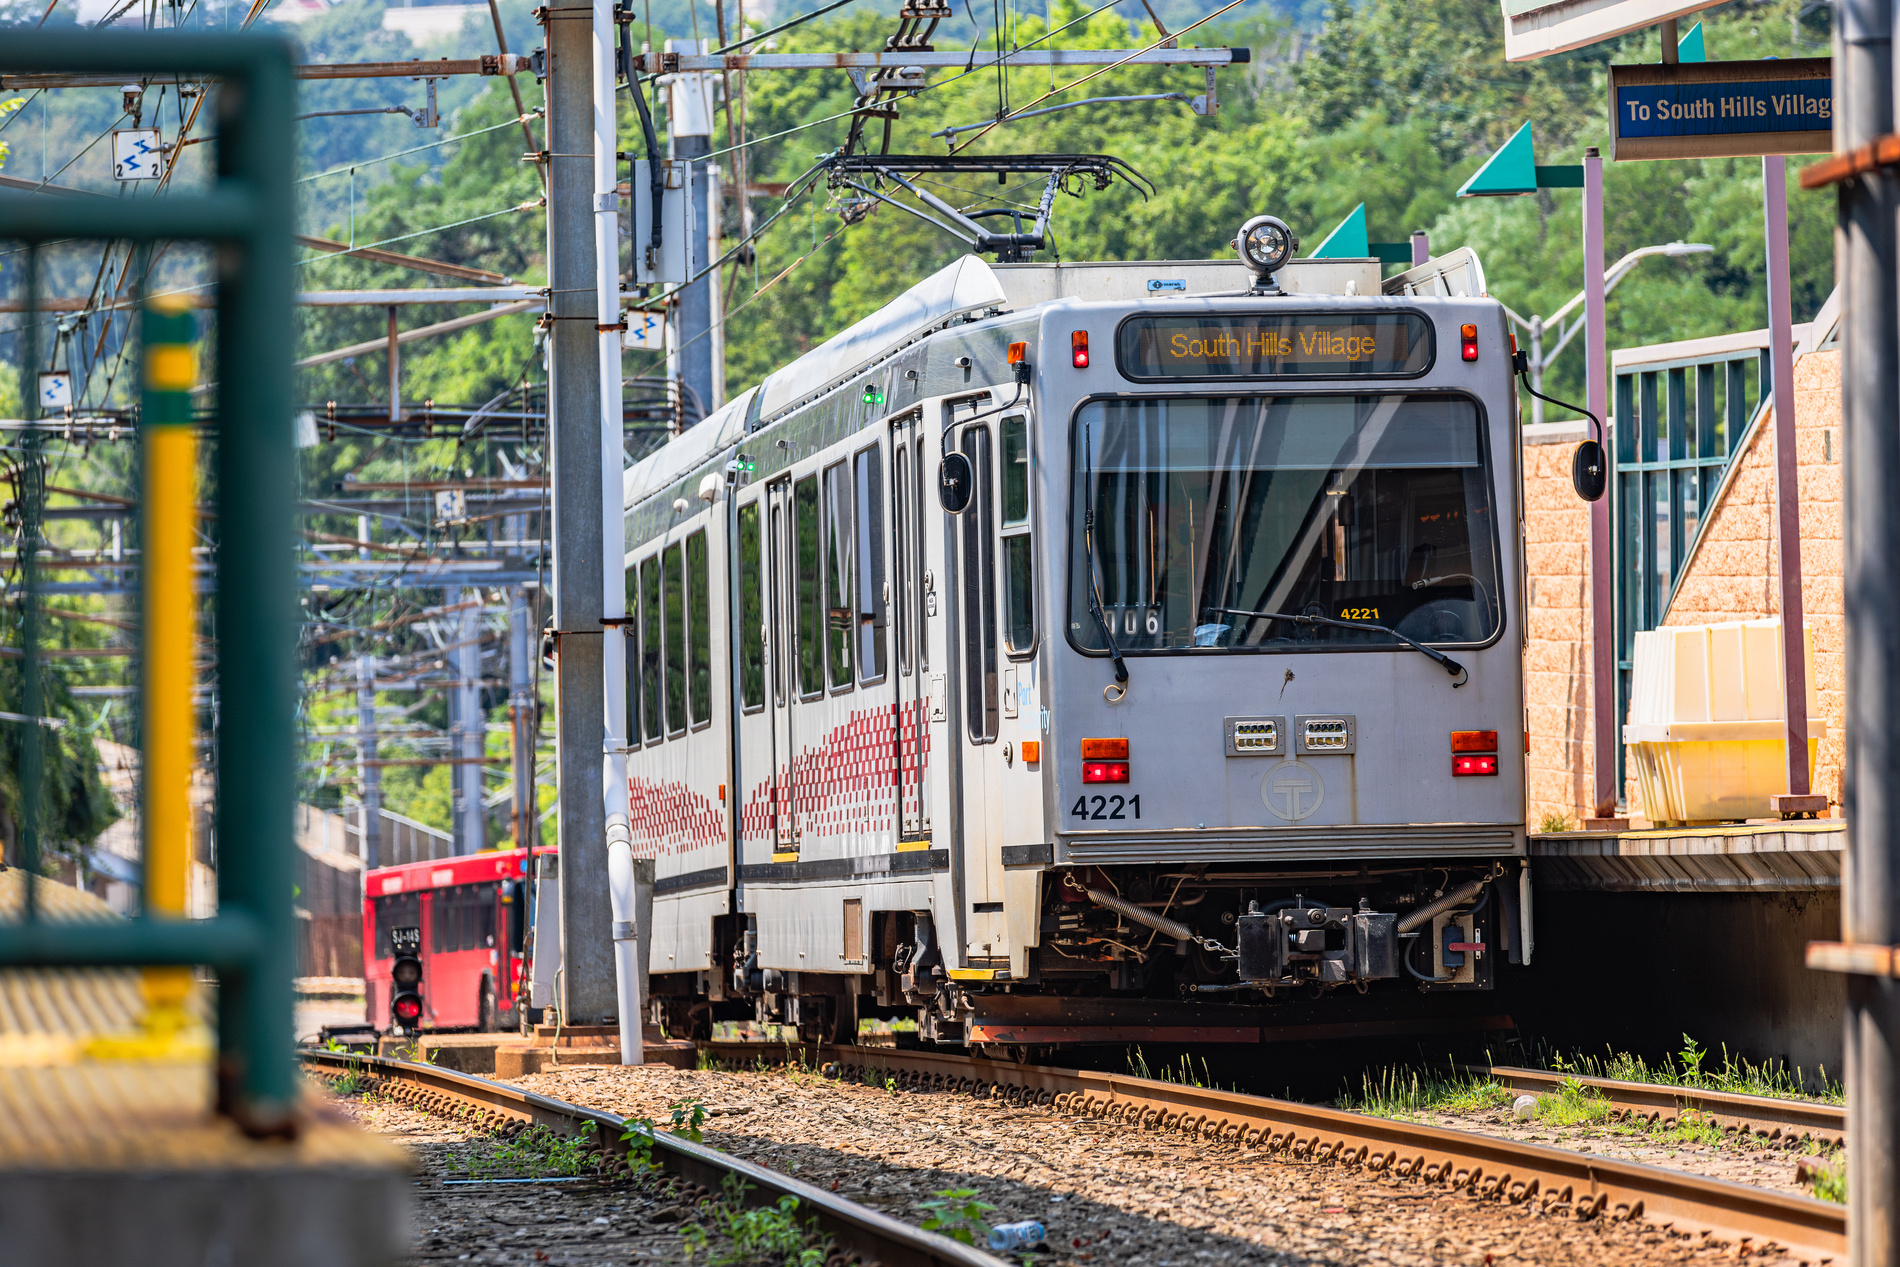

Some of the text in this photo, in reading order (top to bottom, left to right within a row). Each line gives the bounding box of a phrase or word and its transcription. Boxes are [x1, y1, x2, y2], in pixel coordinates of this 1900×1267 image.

[1626, 100, 1651, 122] To
[1656, 98, 1715, 121] South
[1720, 95, 1767, 118] Hills
[116, 163, 159, 177] 2 2
[1170, 331, 1376, 361] South Hills Village
[1340, 607, 1380, 620] 4221
[1017, 681, 1032, 707] Port
[1071, 794, 1141, 821] 4221
